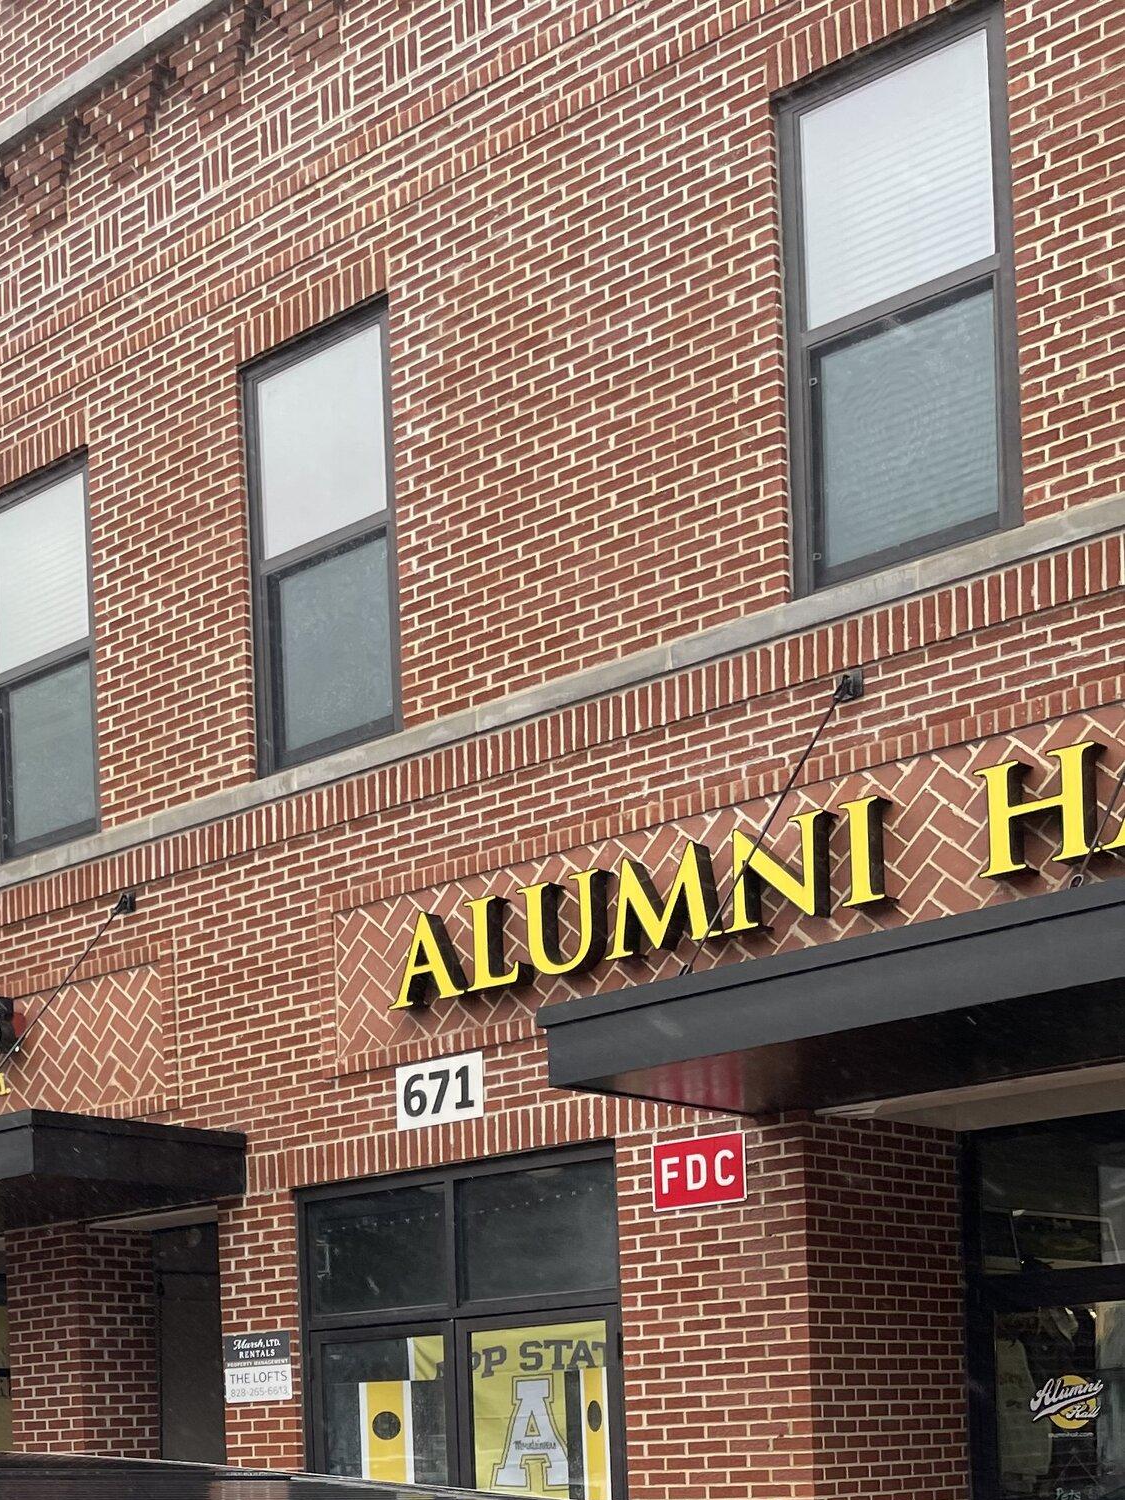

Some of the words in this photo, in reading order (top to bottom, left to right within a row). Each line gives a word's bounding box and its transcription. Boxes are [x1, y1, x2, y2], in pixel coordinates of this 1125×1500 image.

[388, 795, 884, 1009] ALUMNI
[973, 740, 1125, 878] H
[402, 1065, 475, 1117] 671
[661, 1148, 736, 1195] FDC
[238, 1348, 276, 1359] RENTALS
[229, 1373, 251, 1385] THE
[253, 1370, 288, 1384] LOFTS
[1030, 1378, 1105, 1412] Alumni
